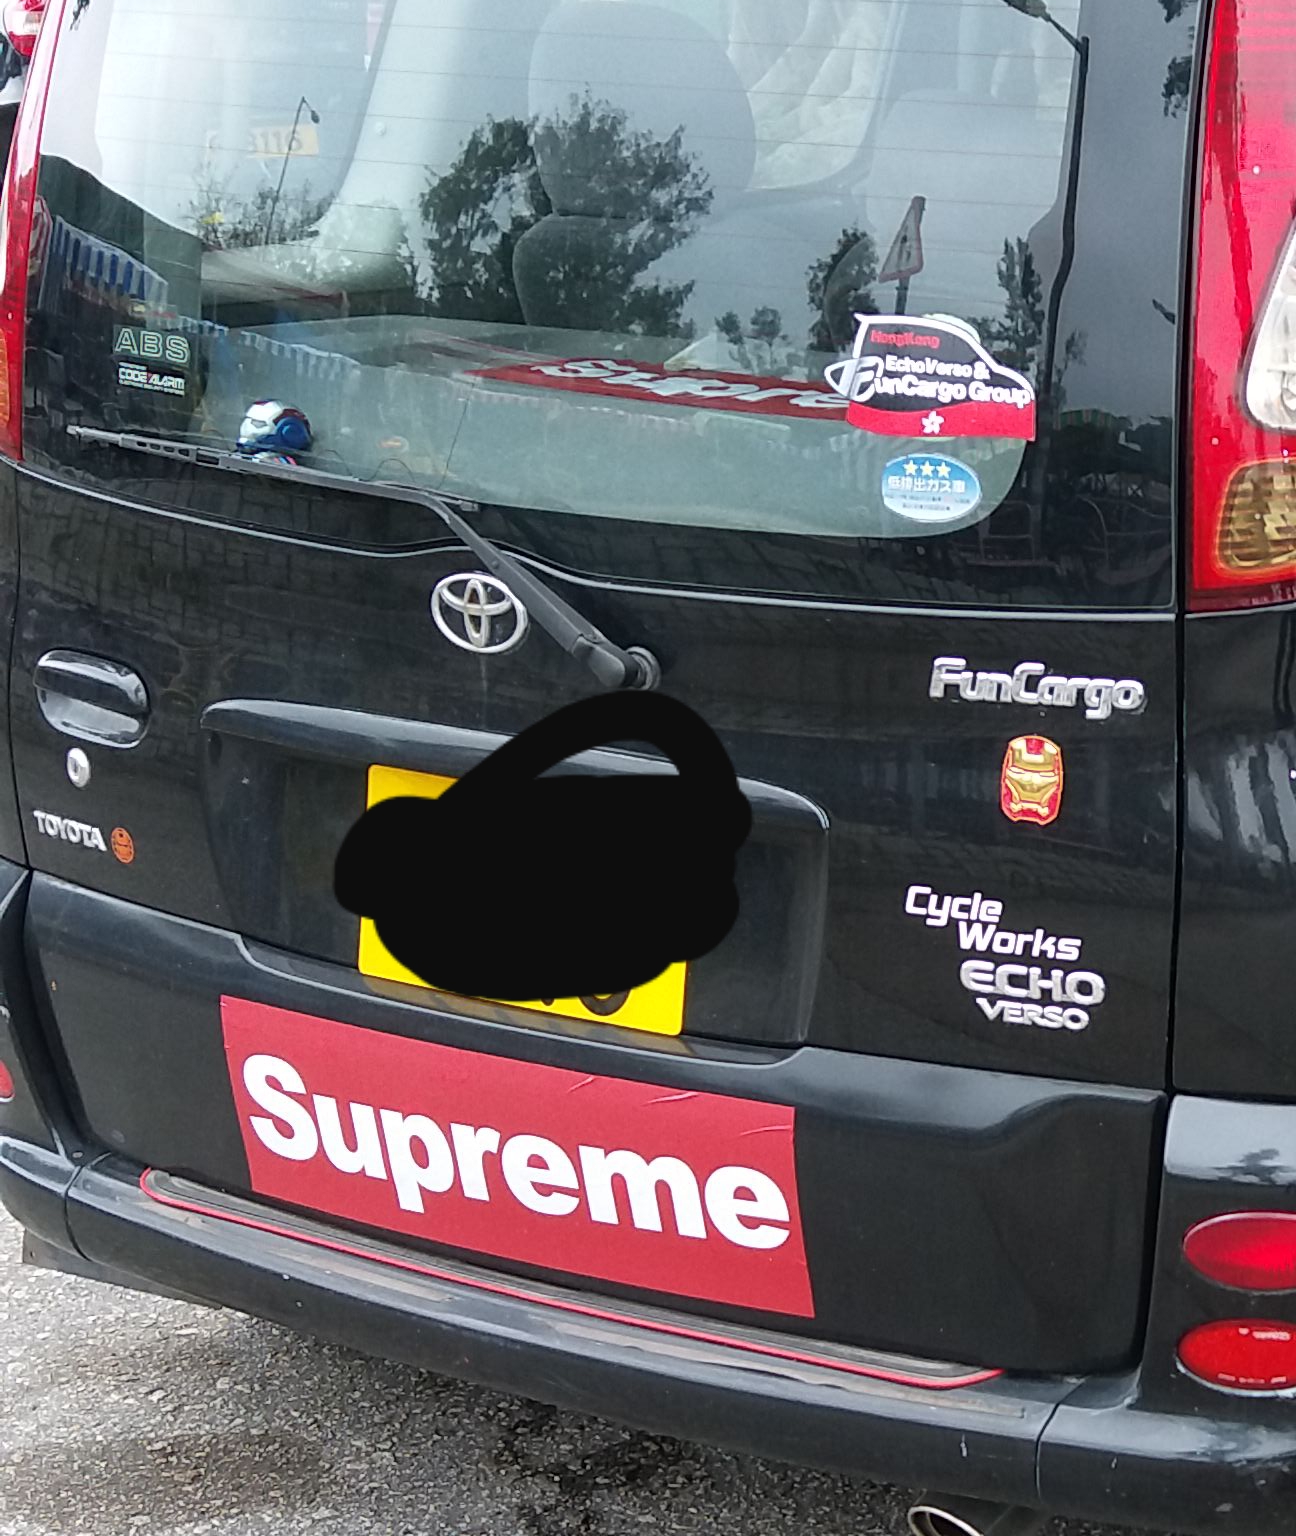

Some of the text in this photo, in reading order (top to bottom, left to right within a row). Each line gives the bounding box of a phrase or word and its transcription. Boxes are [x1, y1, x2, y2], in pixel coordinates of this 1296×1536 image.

[115, 328, 189, 363] ABS
[118, 368, 147, 383] CODE
[530, 359, 848, 408] Supre
[885, 354, 990, 379] EchoVerso &
[968, 381, 1031, 408] Group
[929, 656, 1148, 720] FunCargo
[33, 810, 107, 851] TOYOTA
[904, 884, 1003, 927] Cycle
[958, 921, 1082, 961] Works
[959, 960, 1106, 1005] ECHO
[975, 998, 1090, 1031] VERSO
[241, 1054, 792, 1250] Supreme
